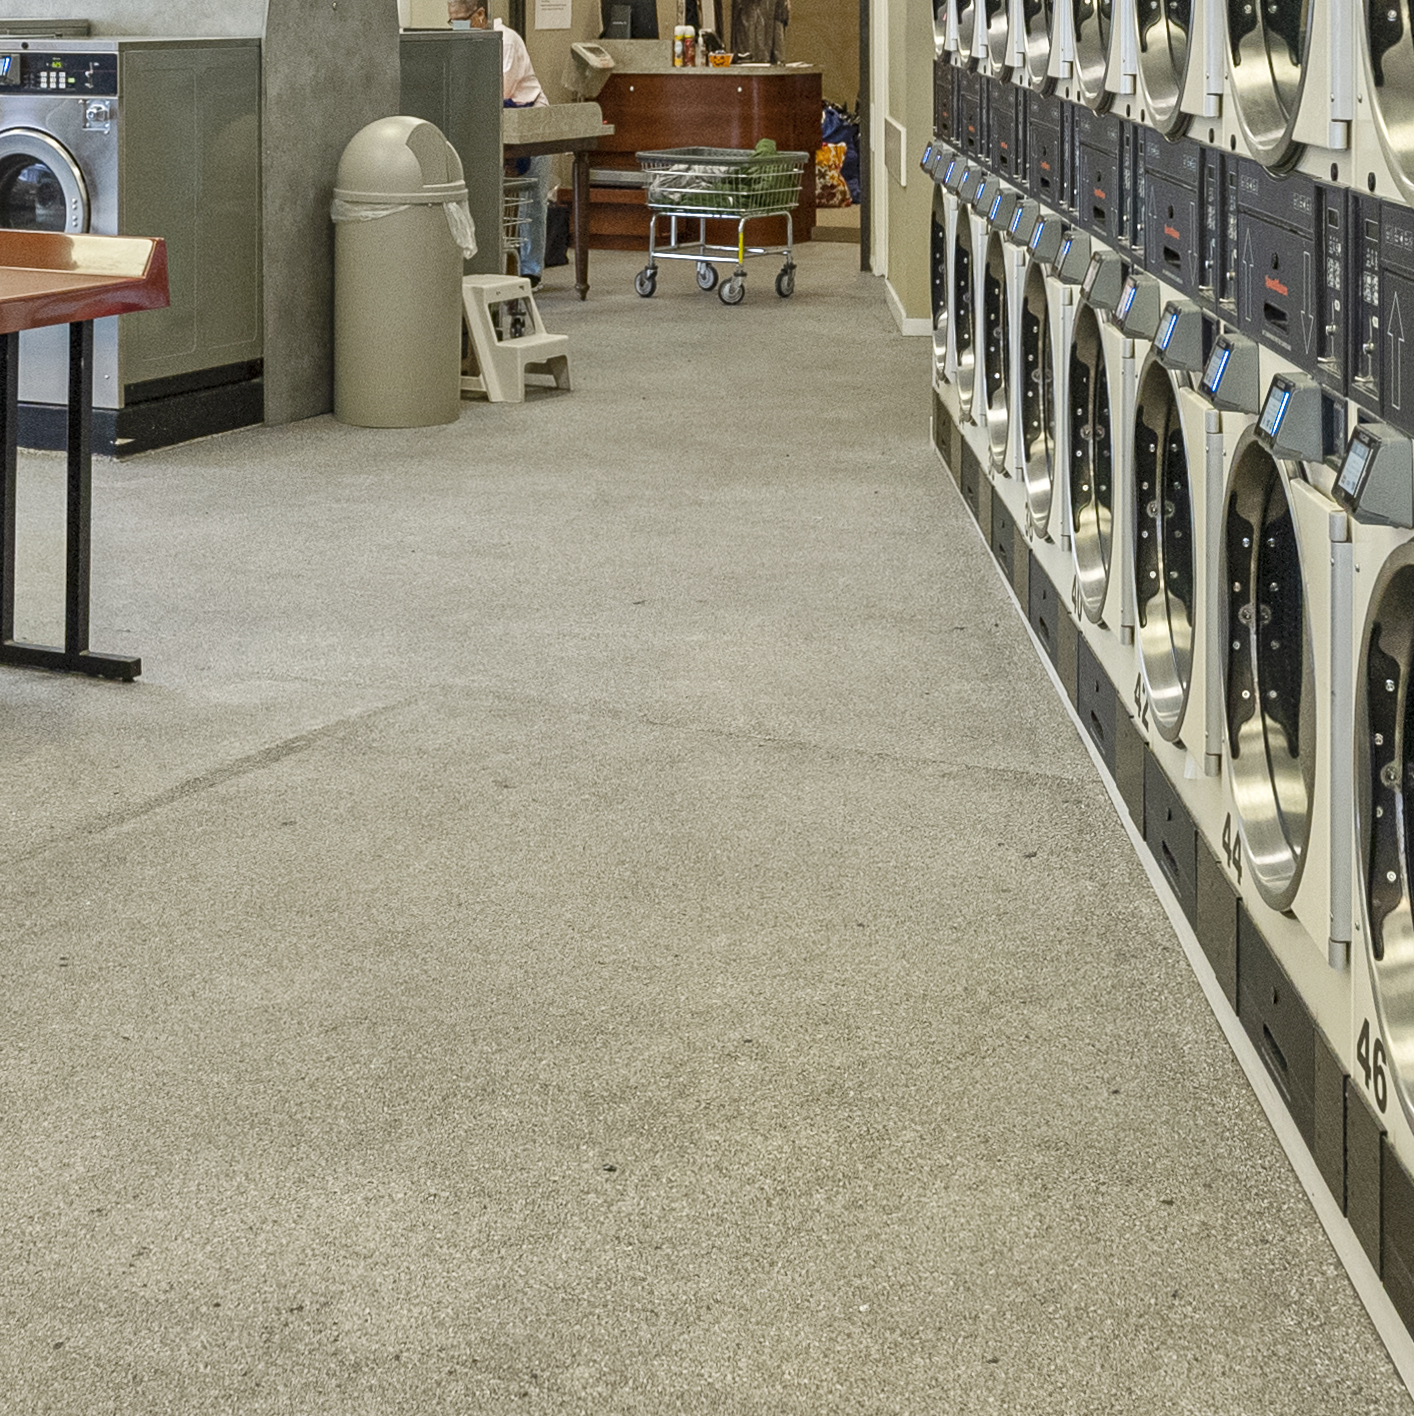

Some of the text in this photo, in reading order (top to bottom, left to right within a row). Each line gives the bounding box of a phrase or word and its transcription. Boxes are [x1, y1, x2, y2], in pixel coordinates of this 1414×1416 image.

[1134, 672, 1149, 732] 42
[1222, 812, 1243, 886] 44
[1357, 1017, 1387, 1113] 46
